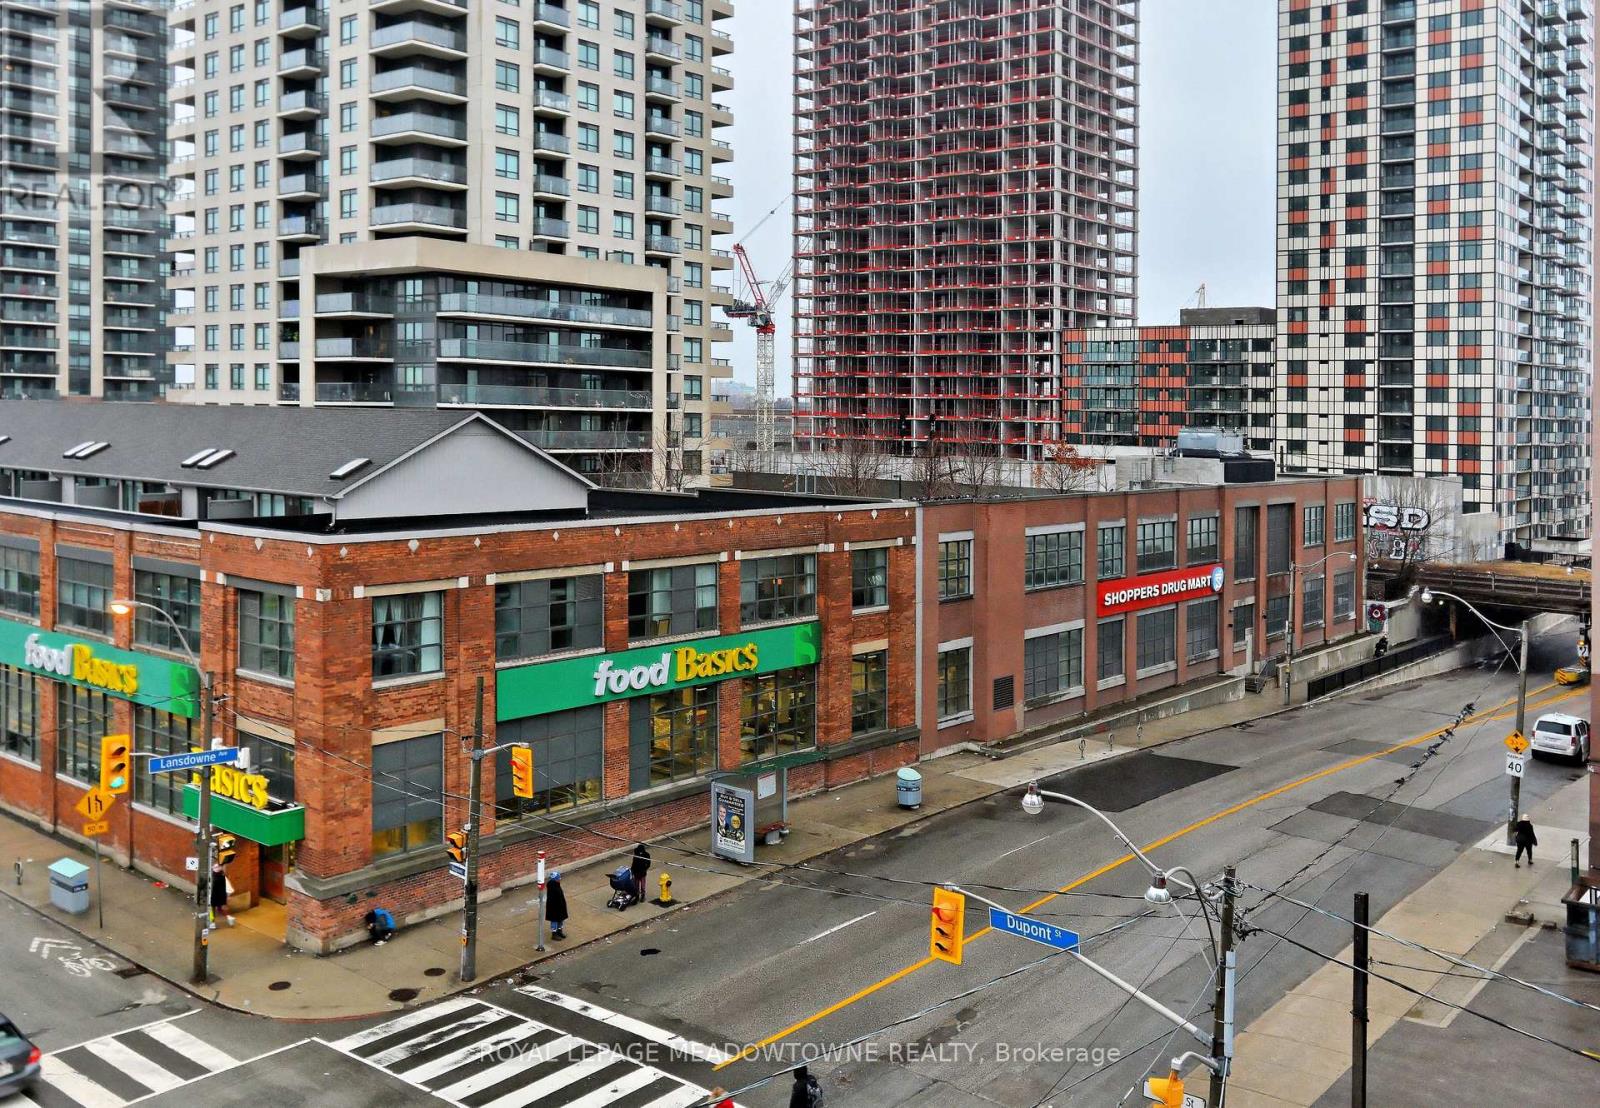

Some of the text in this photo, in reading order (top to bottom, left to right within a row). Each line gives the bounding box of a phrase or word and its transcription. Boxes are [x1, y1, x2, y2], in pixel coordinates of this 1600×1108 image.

[1362, 504, 1430, 531] SD
[1104, 575, 1212, 606] SHOPPERS DRUG MART
[24, 633, 138, 697] food Basics
[593, 643, 759, 697] food Basics
[160, 753, 217, 769] Lansdowne
[1508, 761, 1522, 773] 40
[1006, 914, 1062, 941] Dupont St
